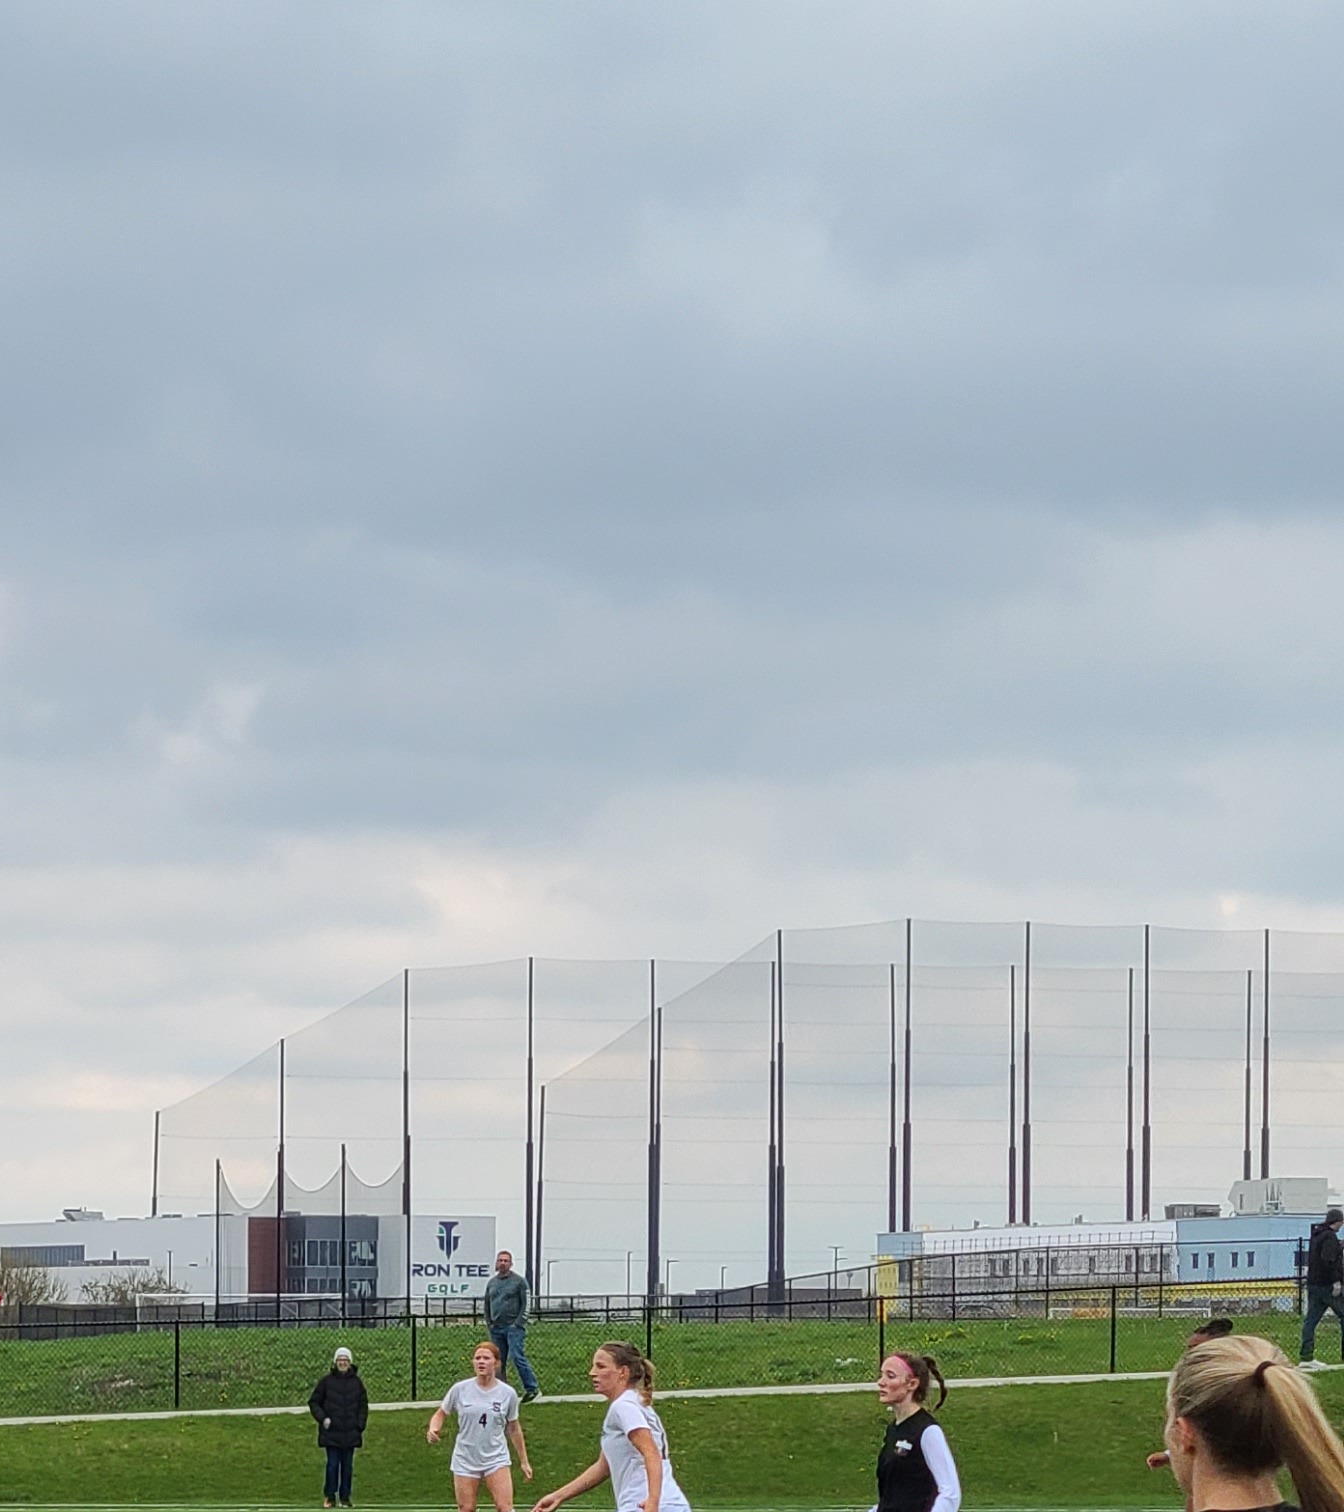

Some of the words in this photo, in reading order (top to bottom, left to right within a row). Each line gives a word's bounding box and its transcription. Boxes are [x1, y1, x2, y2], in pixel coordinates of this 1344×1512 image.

[410, 1263, 451, 1277] RON
[454, 1264, 490, 1277] TEE
[427, 1284, 469, 1295] GOLF
[478, 1413, 487, 1429] 4
